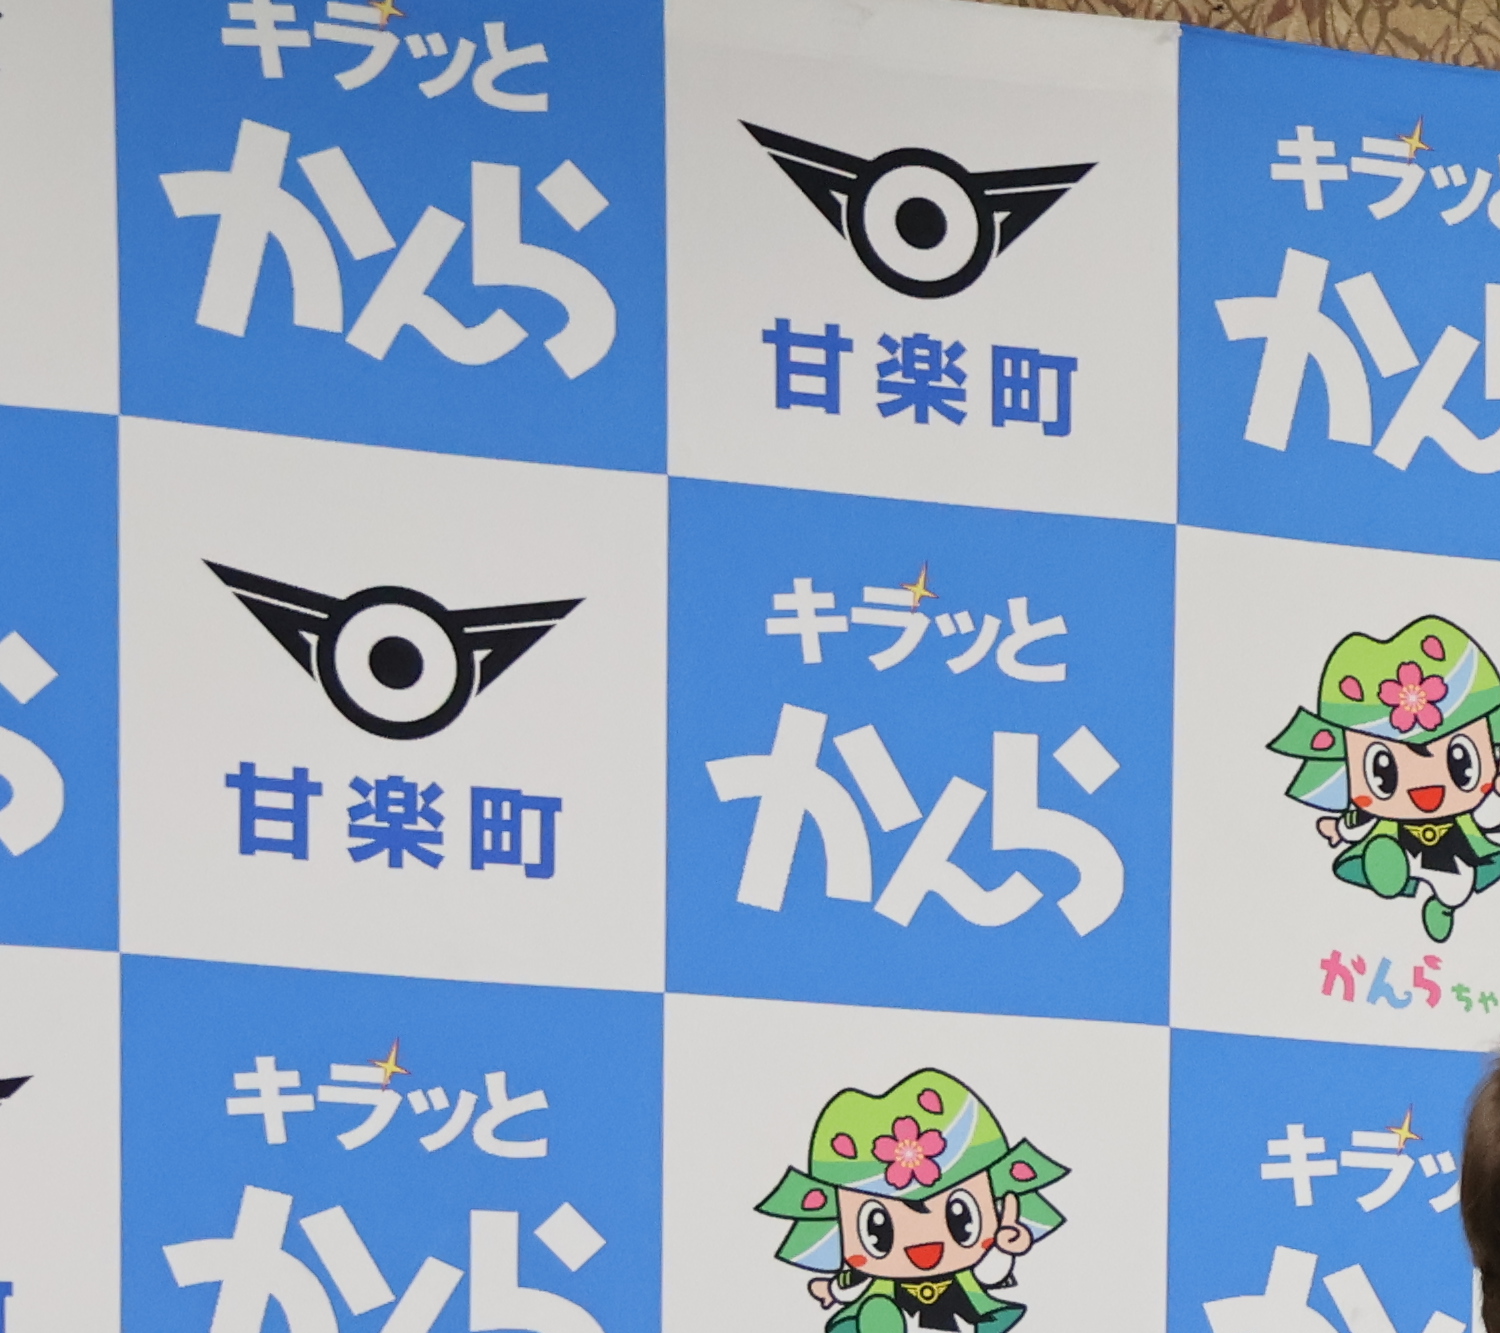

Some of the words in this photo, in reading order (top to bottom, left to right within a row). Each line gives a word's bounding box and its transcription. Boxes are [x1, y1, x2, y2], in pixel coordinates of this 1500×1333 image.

[222, 0, 548, 111] キラッと
[160, 120, 616, 378] かんら
[763, 319, 1077, 436] 甘楽町
[767, 567, 1067, 682] キラッと
[226, 762, 561, 878] 甘楽町
[706, 704, 1124, 936] かんら
[227, 1057, 548, 1158] キラッと
[1261, 1123, 1461, 1213] キラッ
